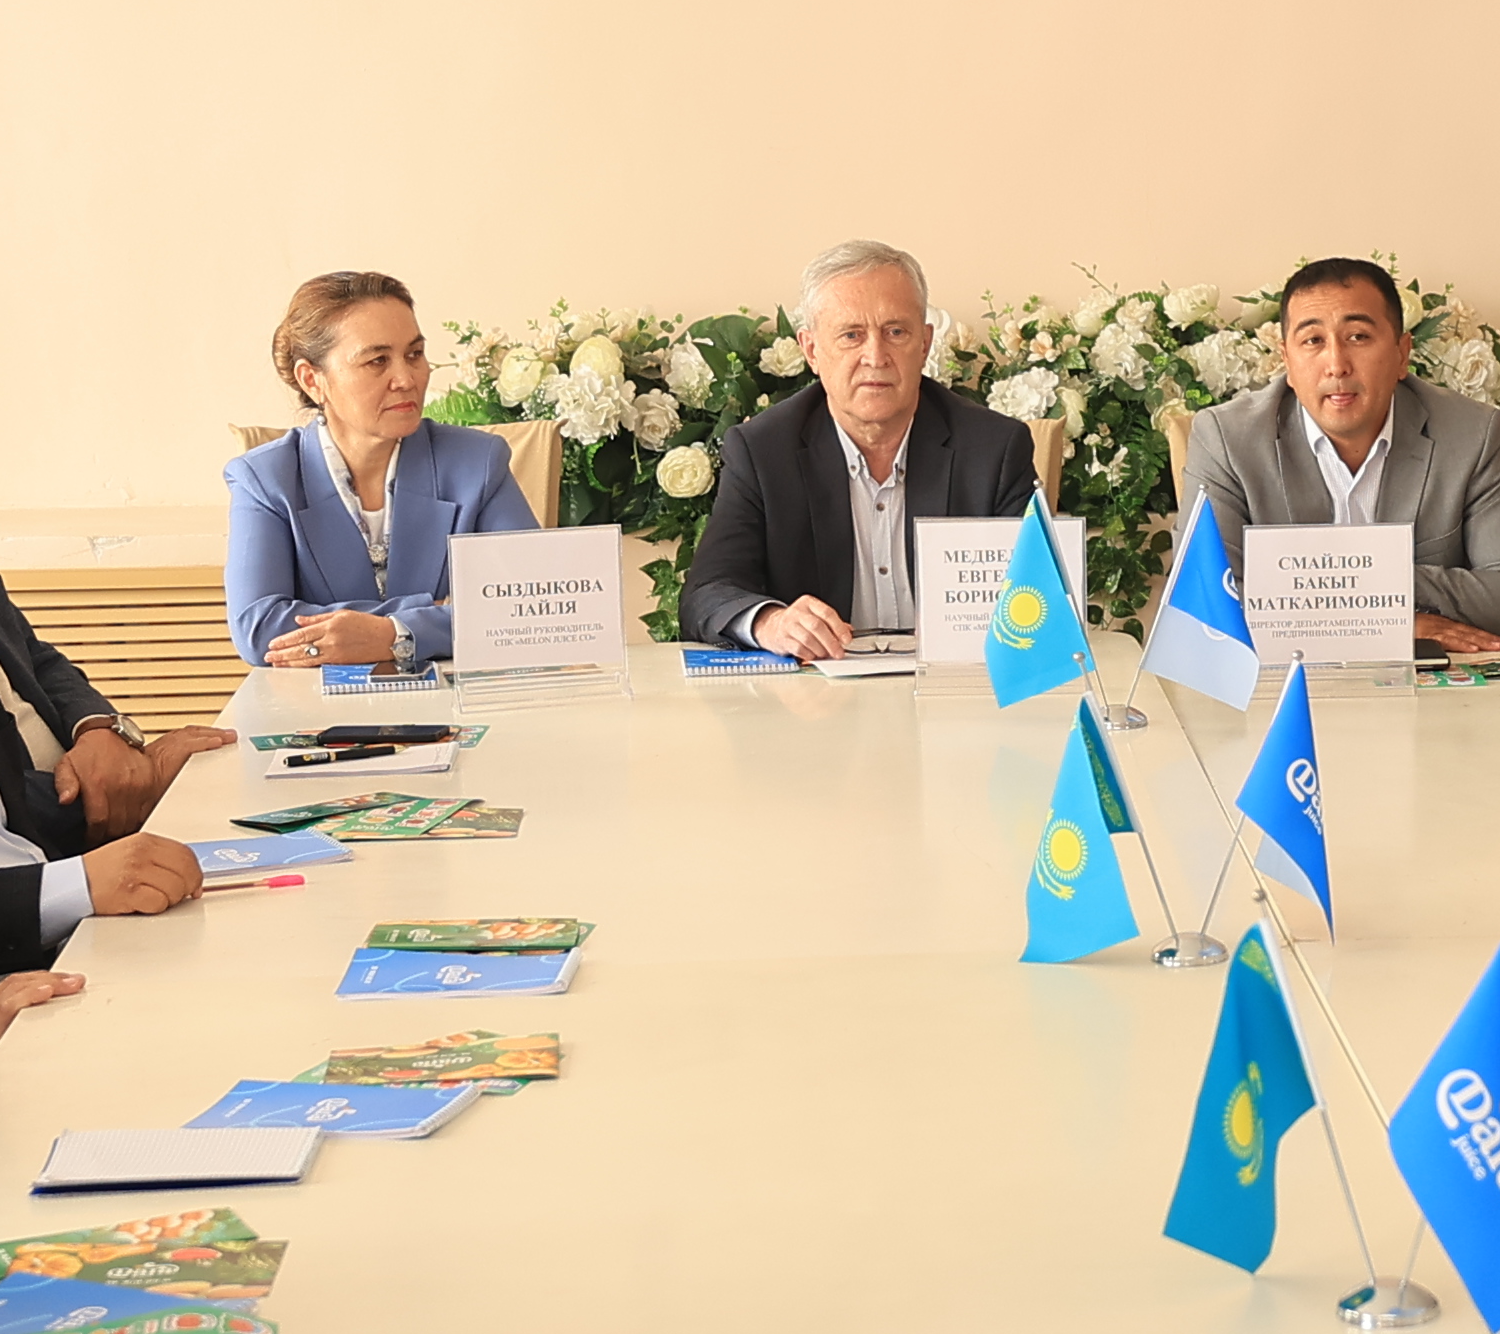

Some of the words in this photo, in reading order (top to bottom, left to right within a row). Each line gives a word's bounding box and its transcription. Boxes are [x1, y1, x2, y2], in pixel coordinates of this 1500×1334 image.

[1278, 553, 1373, 571] СМАЙЛОВ
[958, 569, 1007, 583] ЕВГЕ
[1292, 575, 1360, 590] БАКЫТ
[482, 578, 604, 598] СЫЗДЫКОВА
[510, 598, 577, 617] ЛАЙЛЯ
[1247, 594, 1407, 611] МАТКАРИМОВИЧ
[944, 612, 990, 622] НАУЧНЫЙ
[1249, 620, 1292, 629] ДИРЕКТОР
[1294, 619, 1366, 629] ДЕПАРТАМЕНТА
[1367, 618, 1396, 627] НАУКИ
[1399, 618, 1407, 626] И
[486, 625, 532, 637] НАУЧНЫЙ
[533, 623, 604, 635] РУКОВОДИТЕЛЬ
[952, 624, 972, 632] СПК
[1272, 628, 1383, 639] ПРЕДПРИНИМАТЕЛЬСТВА
[494, 638, 514, 647] СПК
[515, 636, 551, 646] «MELON
[553, 635, 578, 643] JUICE
[579, 634, 596, 642] CO»
